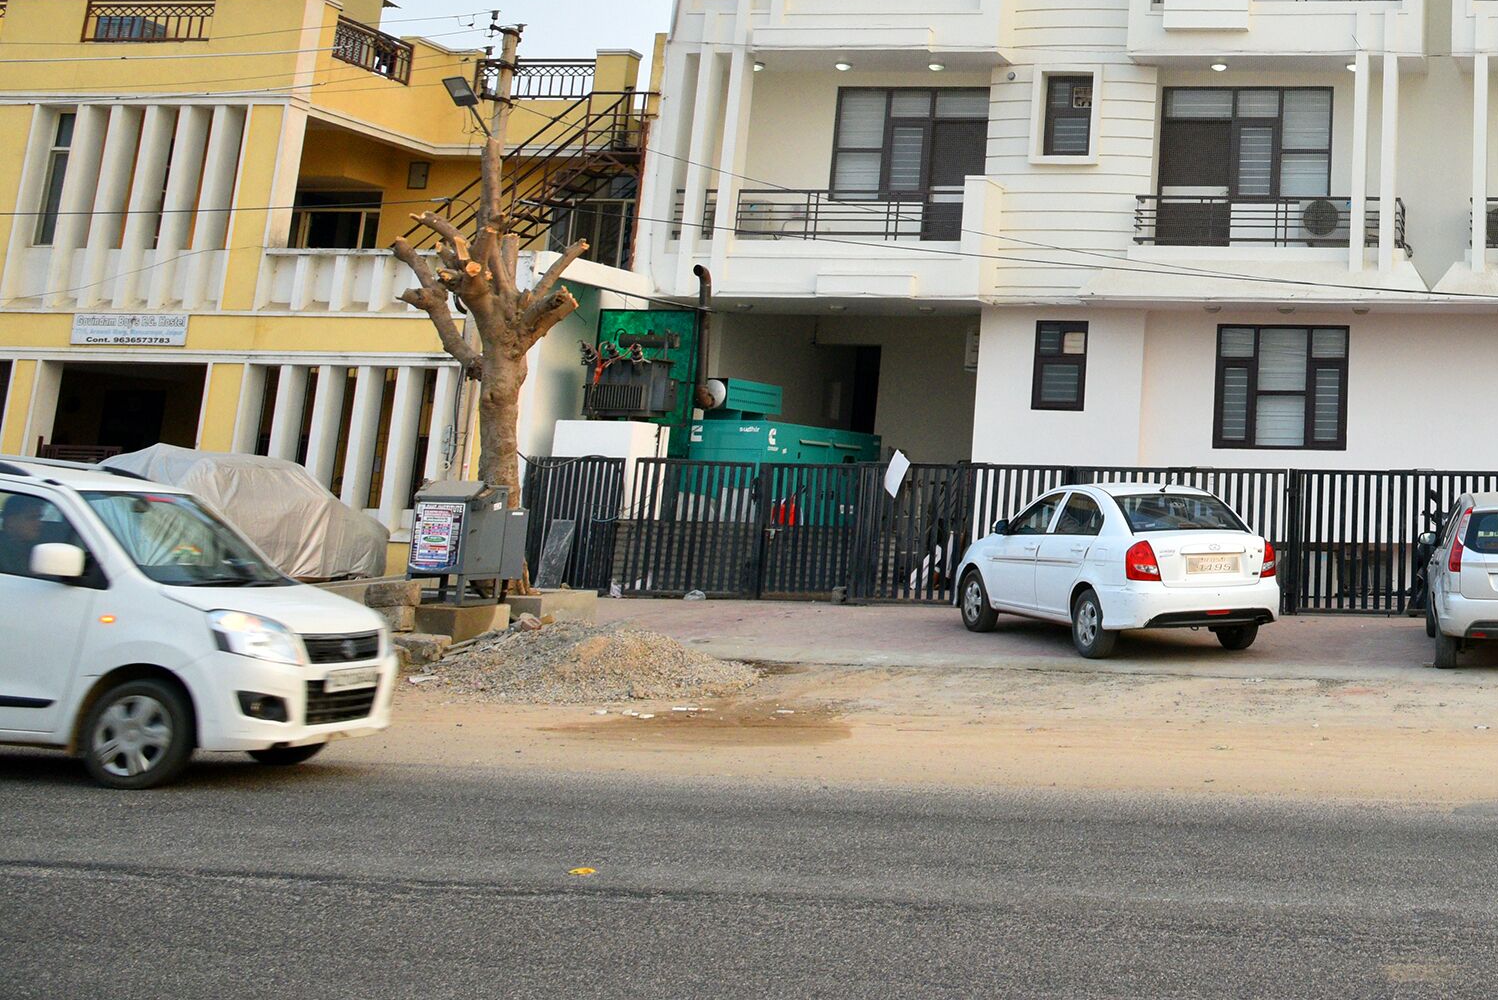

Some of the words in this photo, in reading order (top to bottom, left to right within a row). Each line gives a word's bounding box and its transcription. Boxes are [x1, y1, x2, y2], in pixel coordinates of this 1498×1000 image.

[77, 315, 117, 327] Govindam
[158, 316, 186, 328] Hostel
[113, 336, 170, 344] 9636573783
